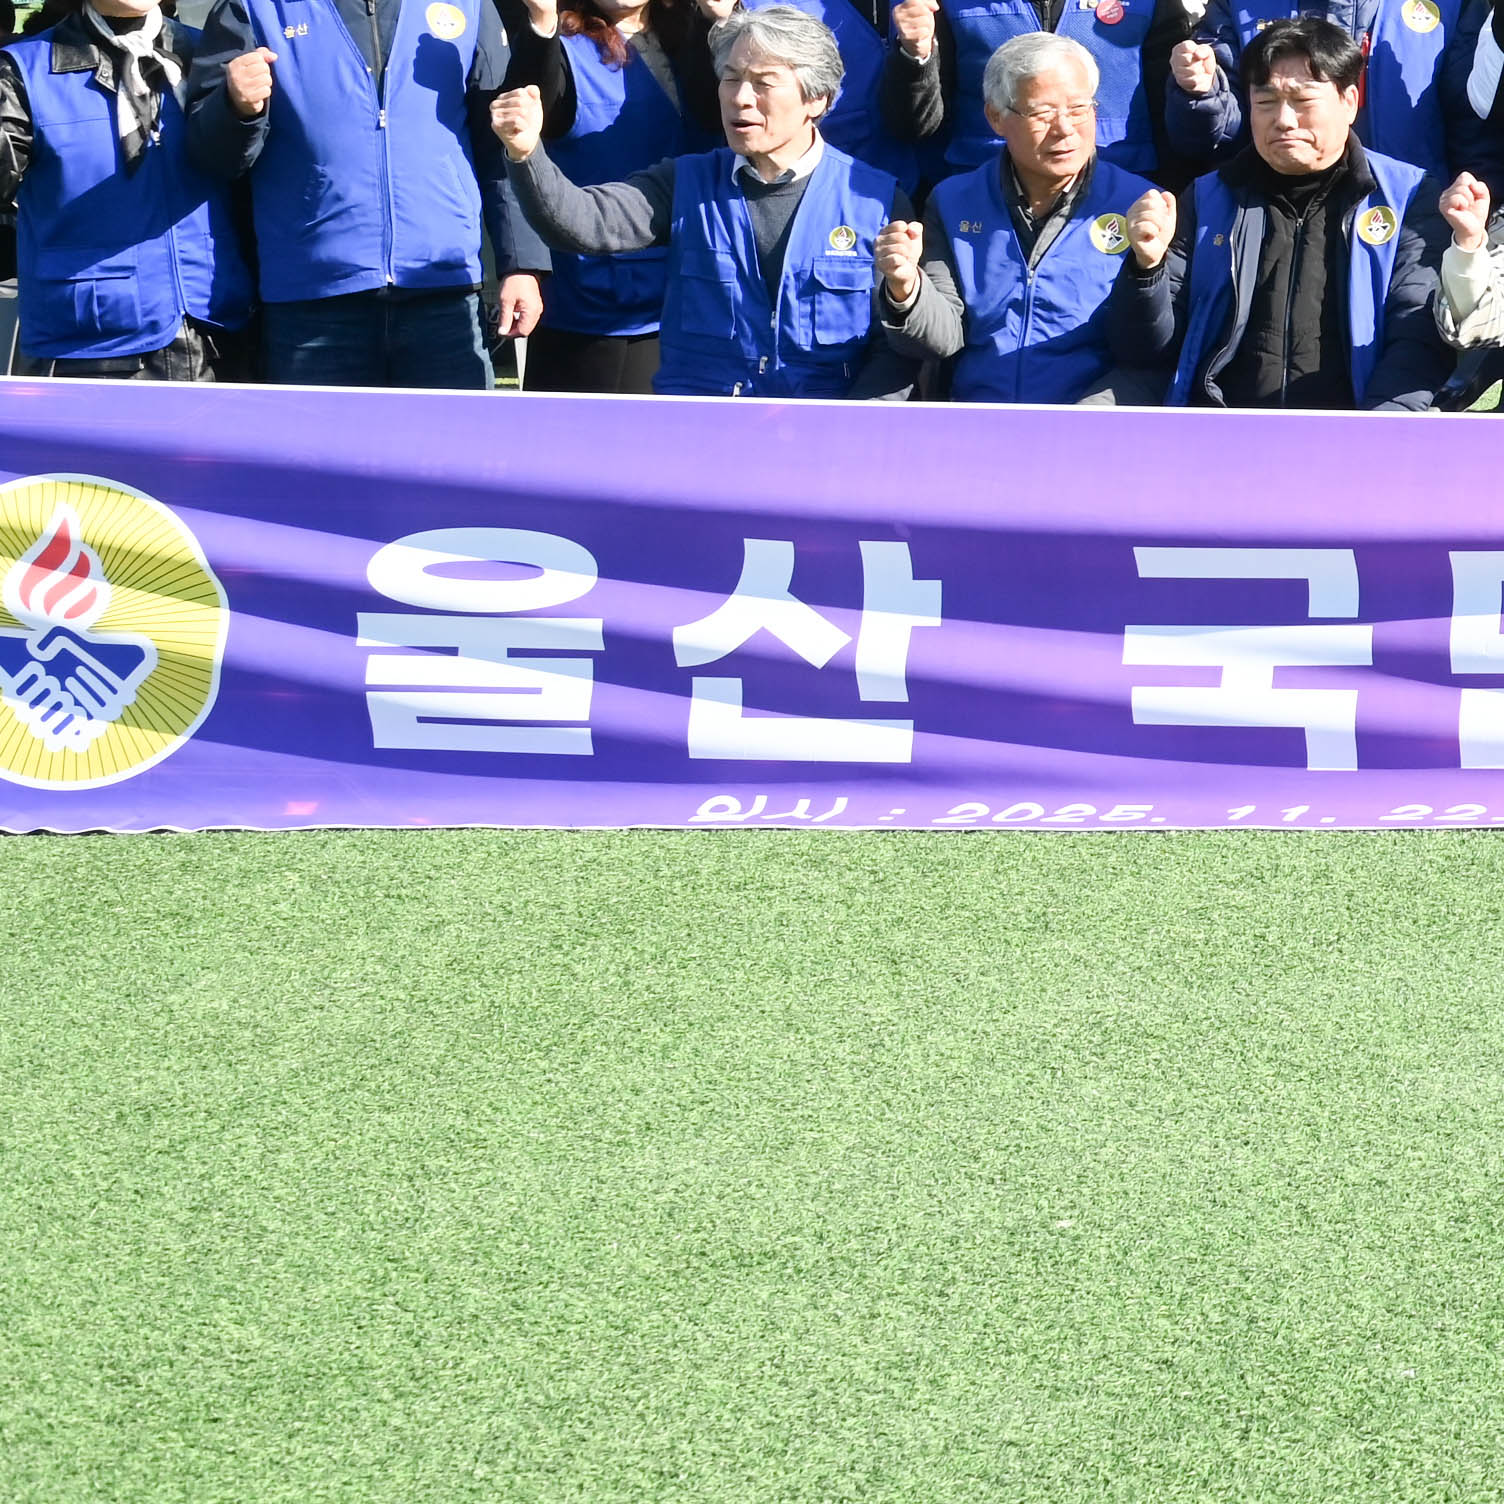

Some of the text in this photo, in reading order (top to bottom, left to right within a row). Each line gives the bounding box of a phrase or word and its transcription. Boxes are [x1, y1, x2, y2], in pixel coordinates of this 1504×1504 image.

[283, 22, 309, 39] 울산
[959, 220, 983, 234] 울산
[356, 527, 942, 764] 울산
